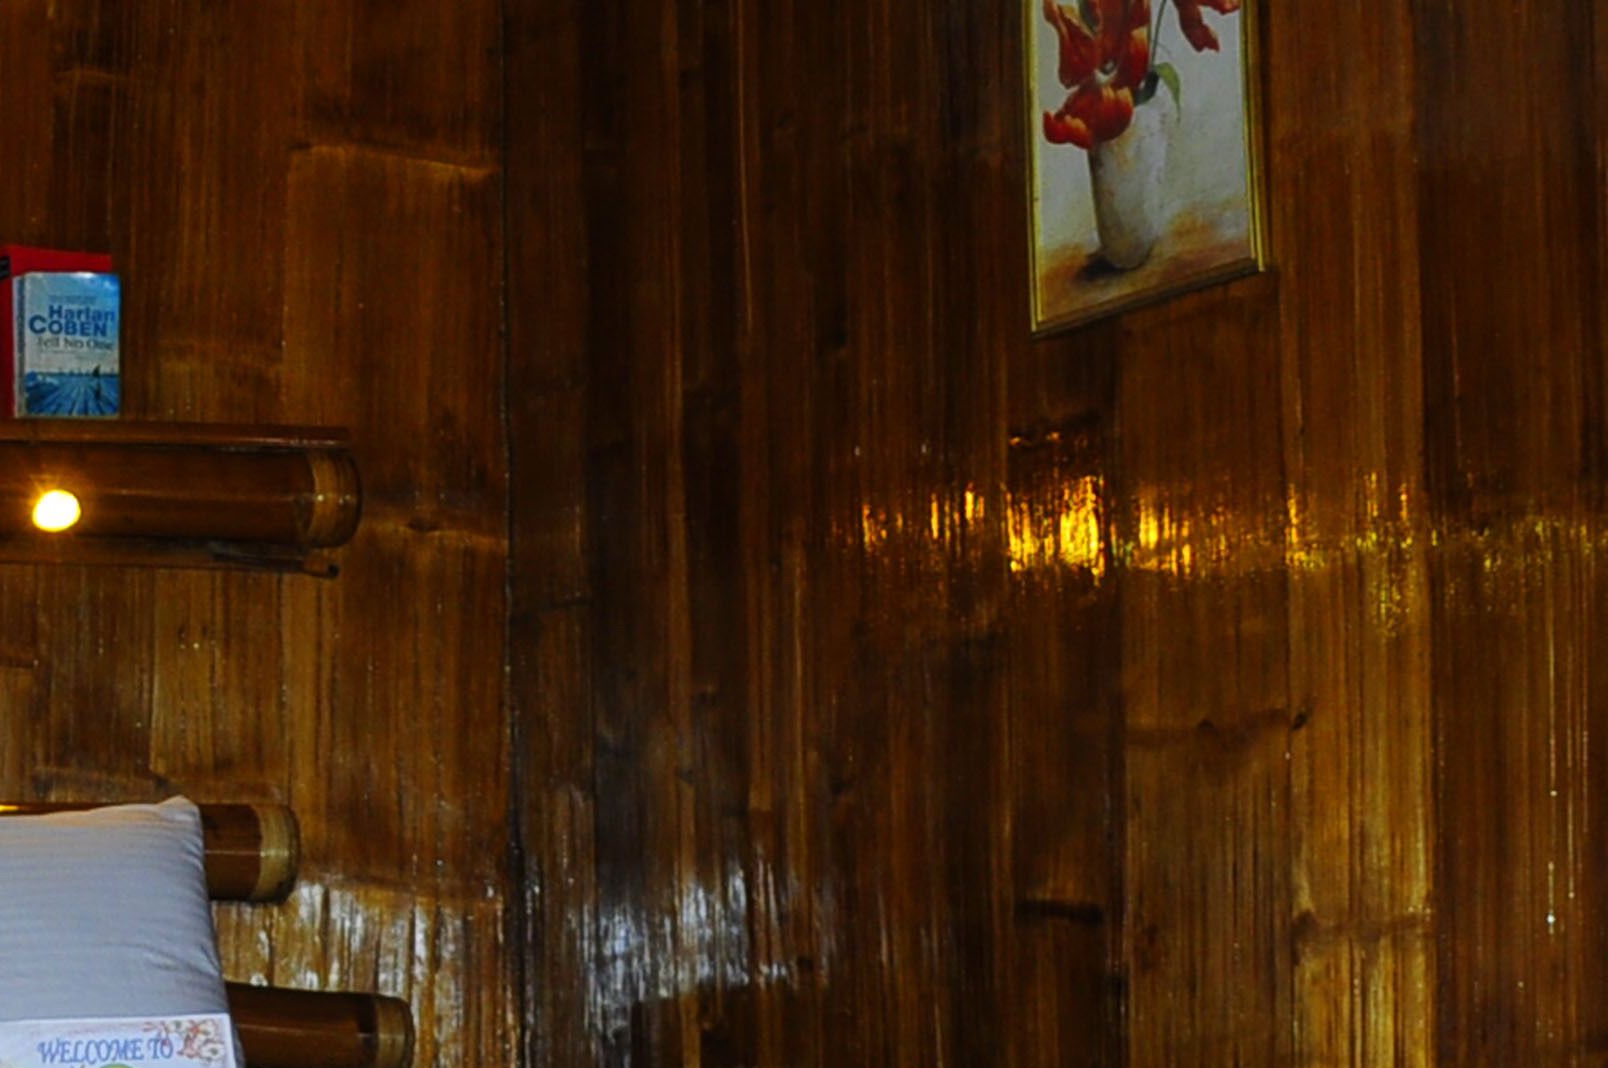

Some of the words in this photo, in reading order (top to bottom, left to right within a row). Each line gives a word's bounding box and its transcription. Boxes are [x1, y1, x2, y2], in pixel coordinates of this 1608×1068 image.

[49, 304, 115, 323] Harlan
[29, 314, 107, 337] COBEN
[37, 1037, 145, 1064] WELCOME
[147, 1035, 174, 1060] TO
